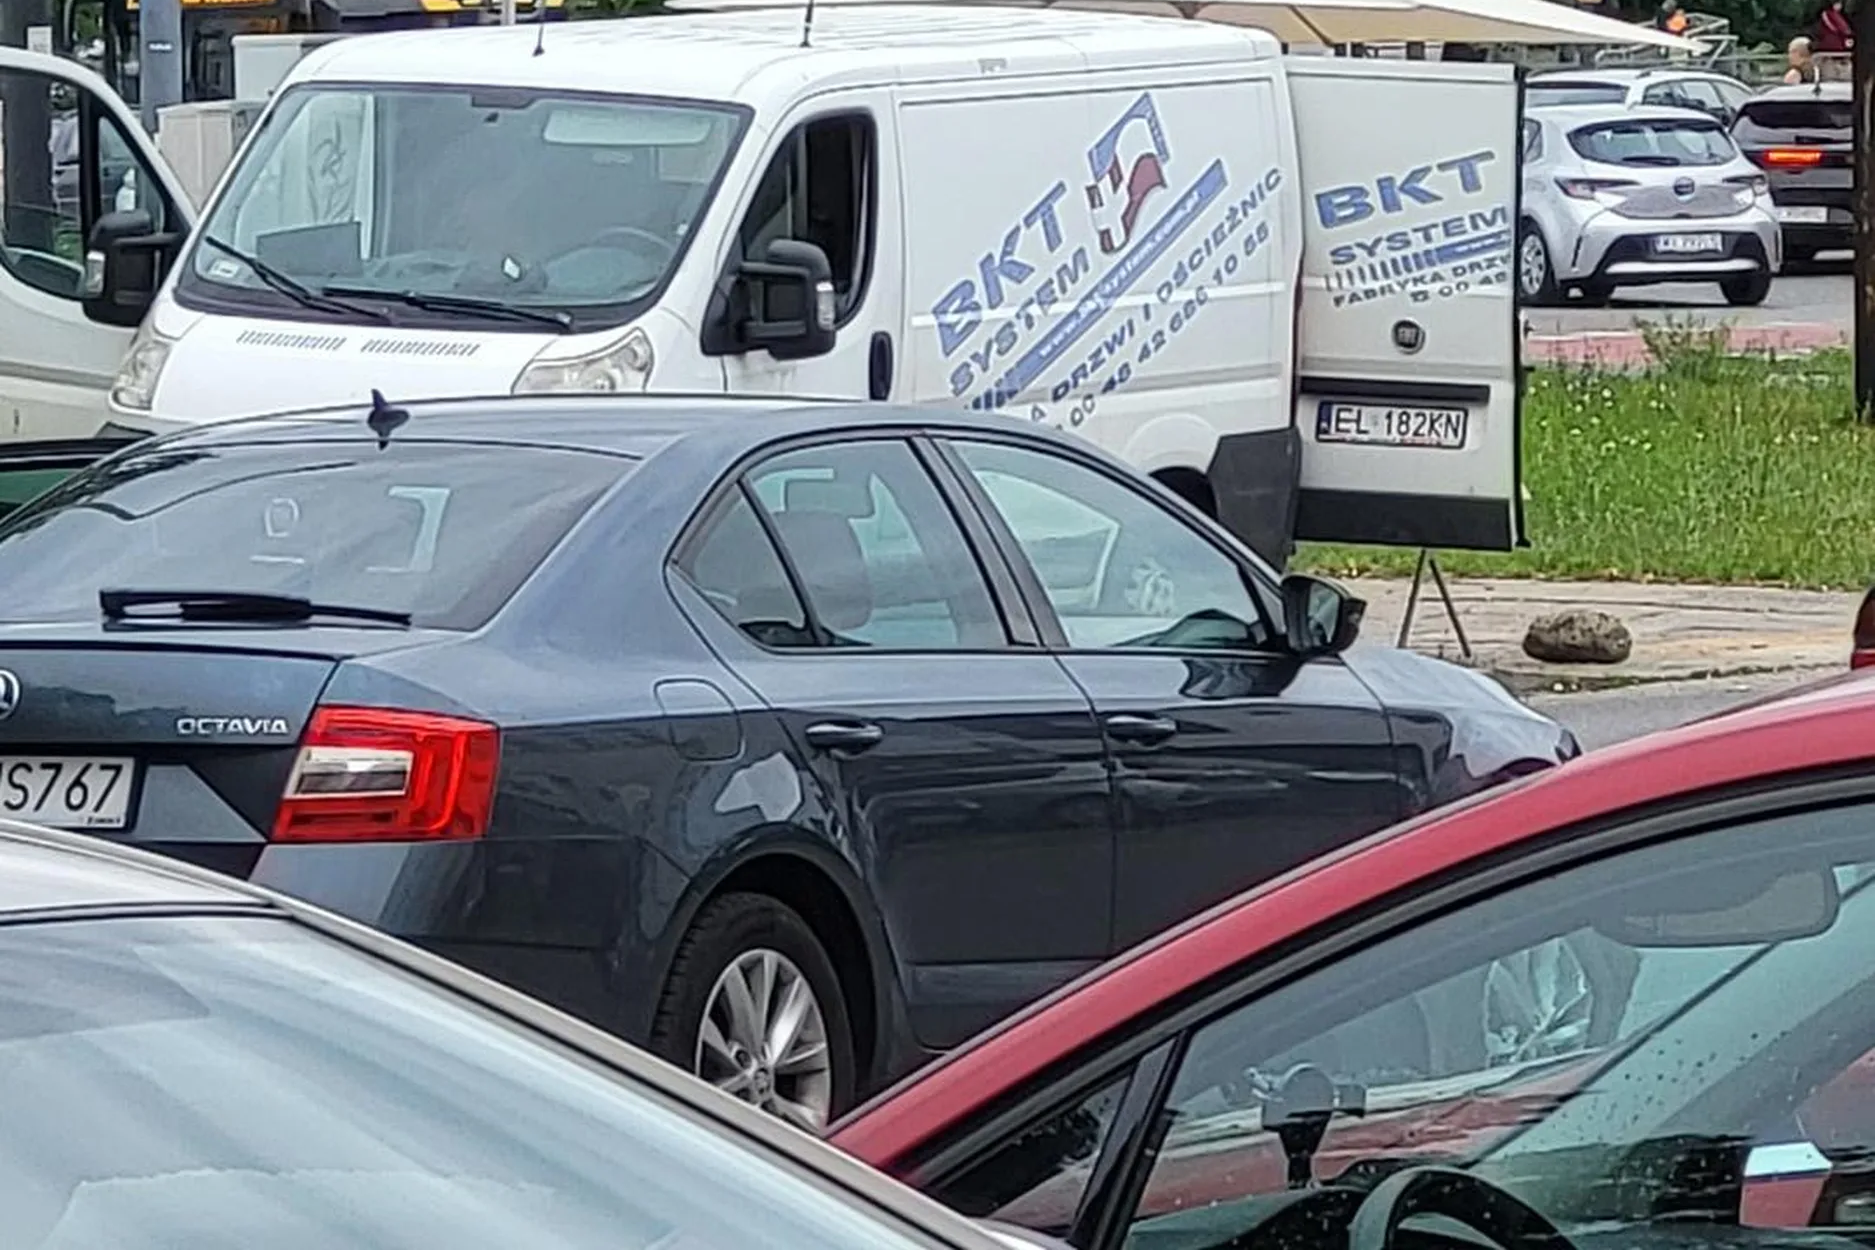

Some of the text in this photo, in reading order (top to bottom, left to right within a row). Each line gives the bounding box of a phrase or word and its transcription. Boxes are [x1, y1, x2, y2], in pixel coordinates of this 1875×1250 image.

[1315, 150, 1496, 229] BKT
[1330, 206, 1508, 265] SYSTEM
[932, 180, 1067, 357] BKT
[1333, 270, 1446, 307] FABRYKA
[951, 246, 1090, 397] SYSTEM
[1052, 318, 1135, 402] DRZWI
[1335, 406, 1461, 439] EL 182KN
[177, 717, 289, 735] OCTAVIA
[0, 762, 123, 813] S767
